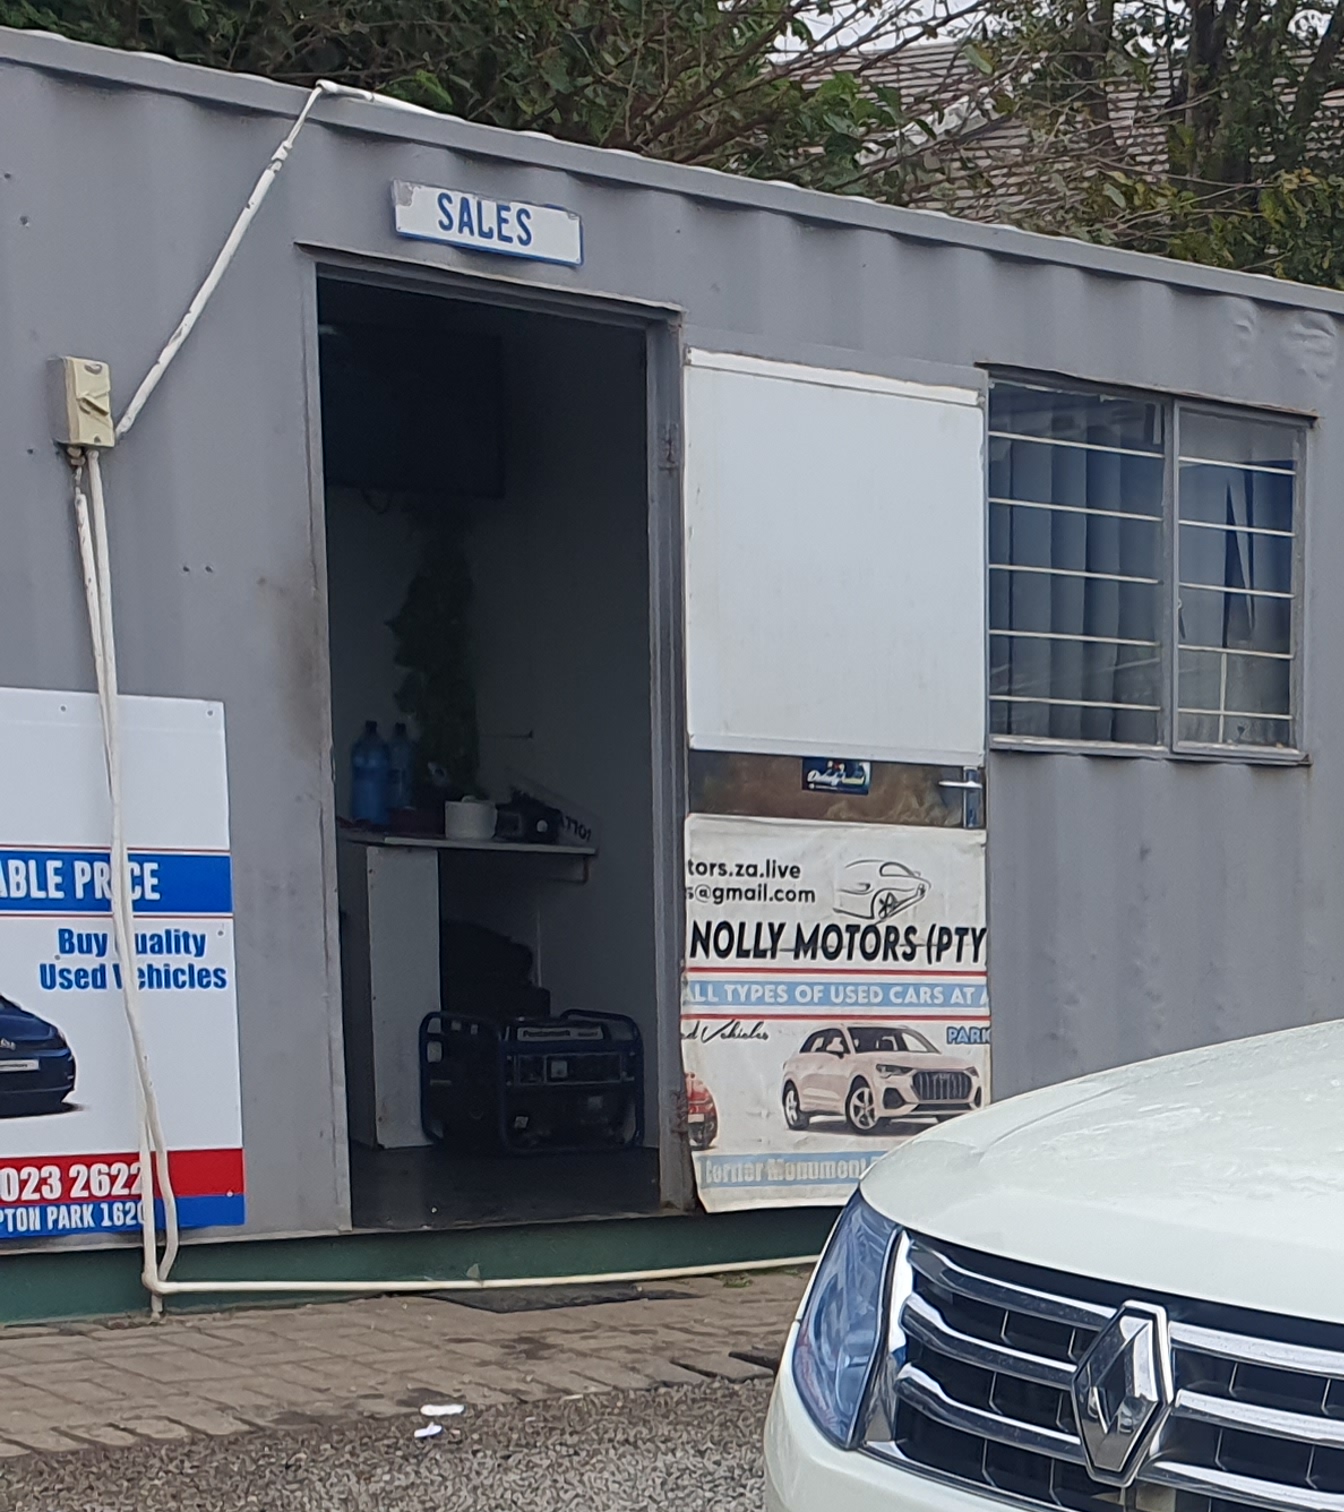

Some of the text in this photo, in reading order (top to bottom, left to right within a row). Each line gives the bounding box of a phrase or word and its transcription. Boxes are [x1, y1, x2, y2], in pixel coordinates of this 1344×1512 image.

[437, 192, 532, 246] SALES
[74, 859, 161, 901] PRCE
[688, 858, 801, 880] tors.za.live
[686, 883, 816, 904] s@gmail.com
[58, 928, 206, 958] Buy uality
[690, 920, 987, 965] NOLLY MOTORS (PTY
[40, 963, 107, 990] Used
[724, 984, 788, 1003] TYPES
[794, 984, 824, 1004] OF
[830, 985, 883, 1004] USED
[891, 985, 944, 1005] CARS
[950, 985, 976, 1005] AT
[701, 1018, 769, 1044] Vehicles
[47, 1204, 95, 1230] PARK
